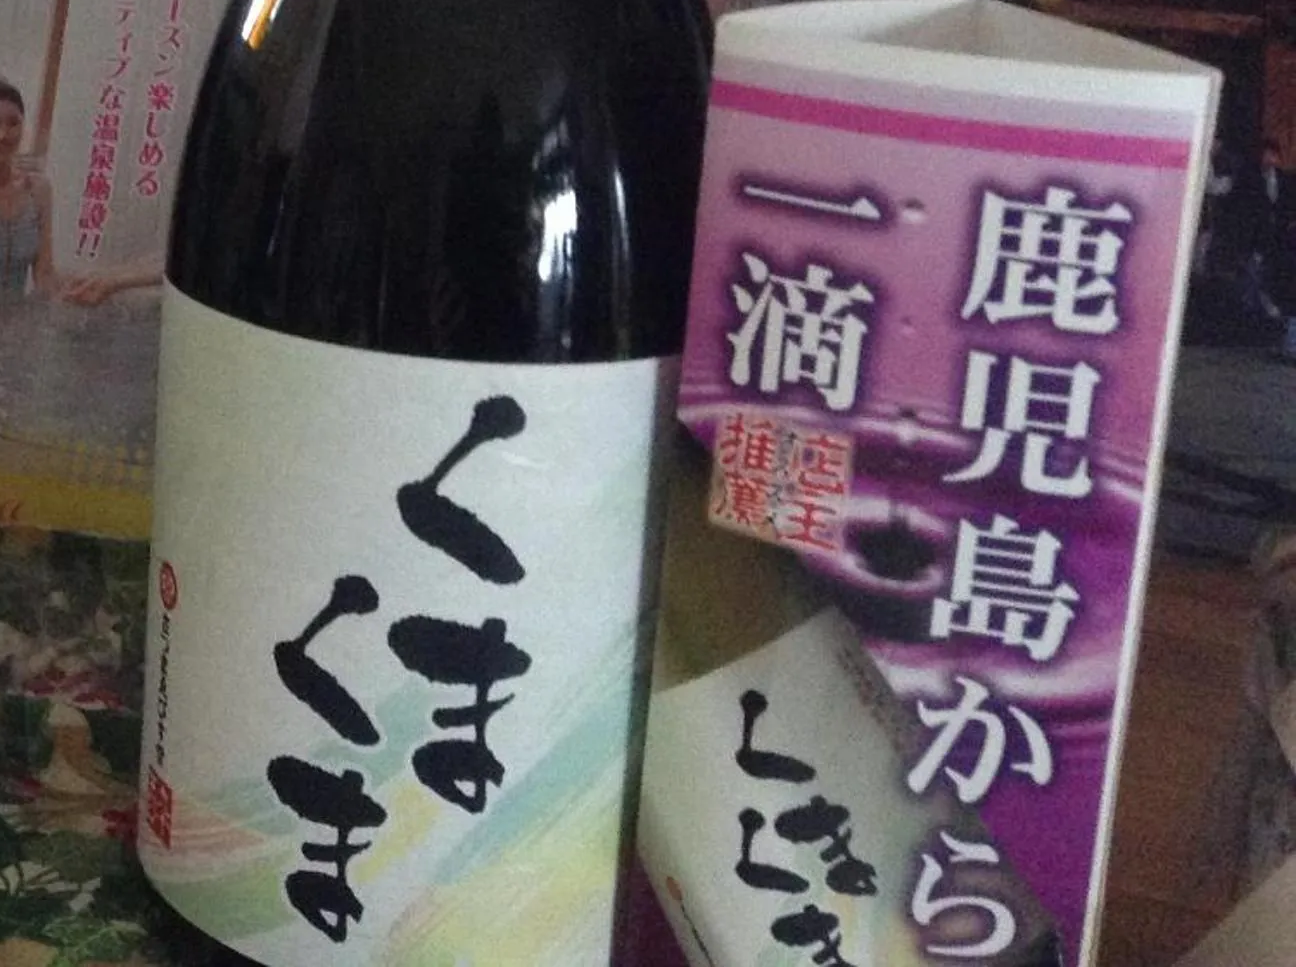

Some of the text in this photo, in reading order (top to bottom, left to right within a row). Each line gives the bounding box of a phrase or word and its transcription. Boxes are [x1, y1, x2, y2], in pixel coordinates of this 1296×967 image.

[726, 185, 882, 413] 一滴
[907, 185, 1133, 958] 鹿児島から
